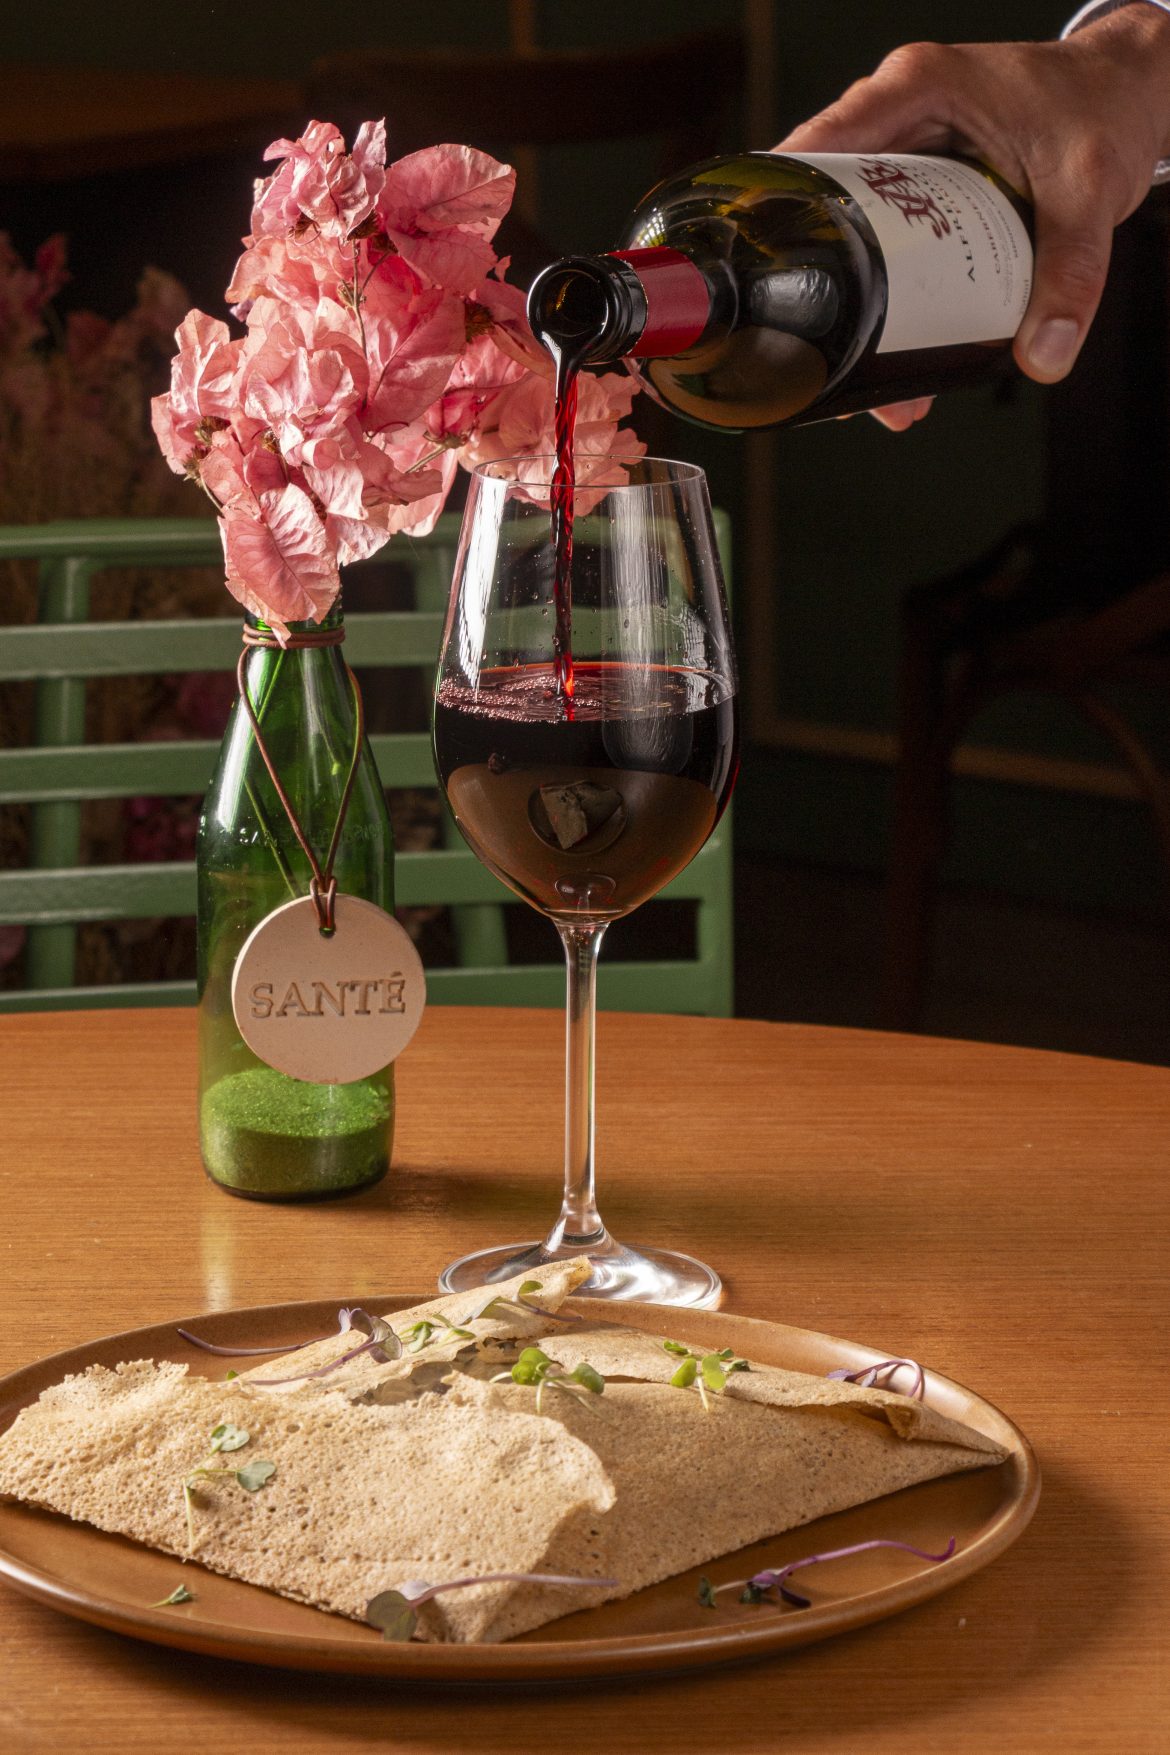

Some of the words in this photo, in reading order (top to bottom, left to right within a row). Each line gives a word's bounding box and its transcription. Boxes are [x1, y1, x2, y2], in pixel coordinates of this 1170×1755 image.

[913, 173, 976, 282] ALFREDO
[964, 194, 1000, 274] CABERNET
[249, 971, 407, 1019] SANTÉ
